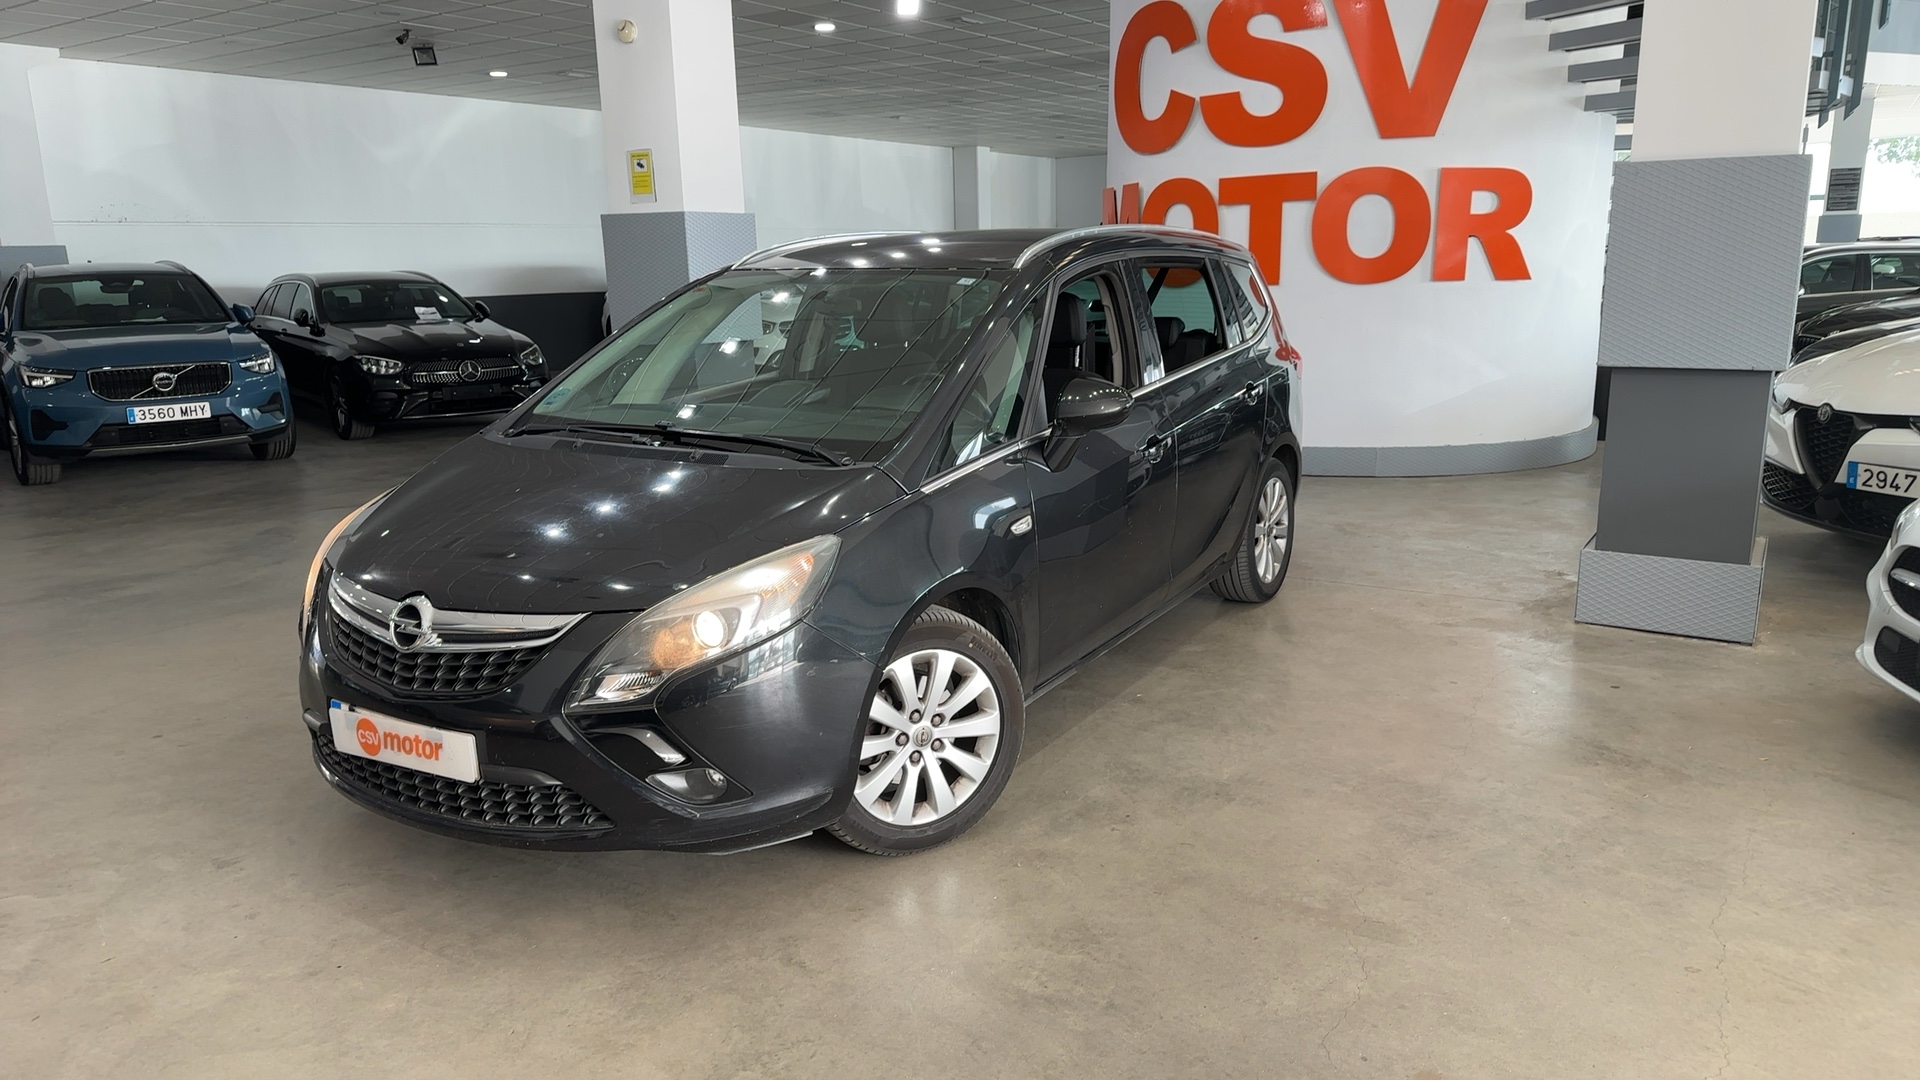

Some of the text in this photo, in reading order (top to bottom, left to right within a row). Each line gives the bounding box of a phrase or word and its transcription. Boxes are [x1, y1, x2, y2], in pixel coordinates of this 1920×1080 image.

[1114, 0, 1490, 155] CSV
[138, 404, 206, 421] 3560 MHY
[1861, 468, 1918, 493] 2947
[383, 730, 443, 761] motor
